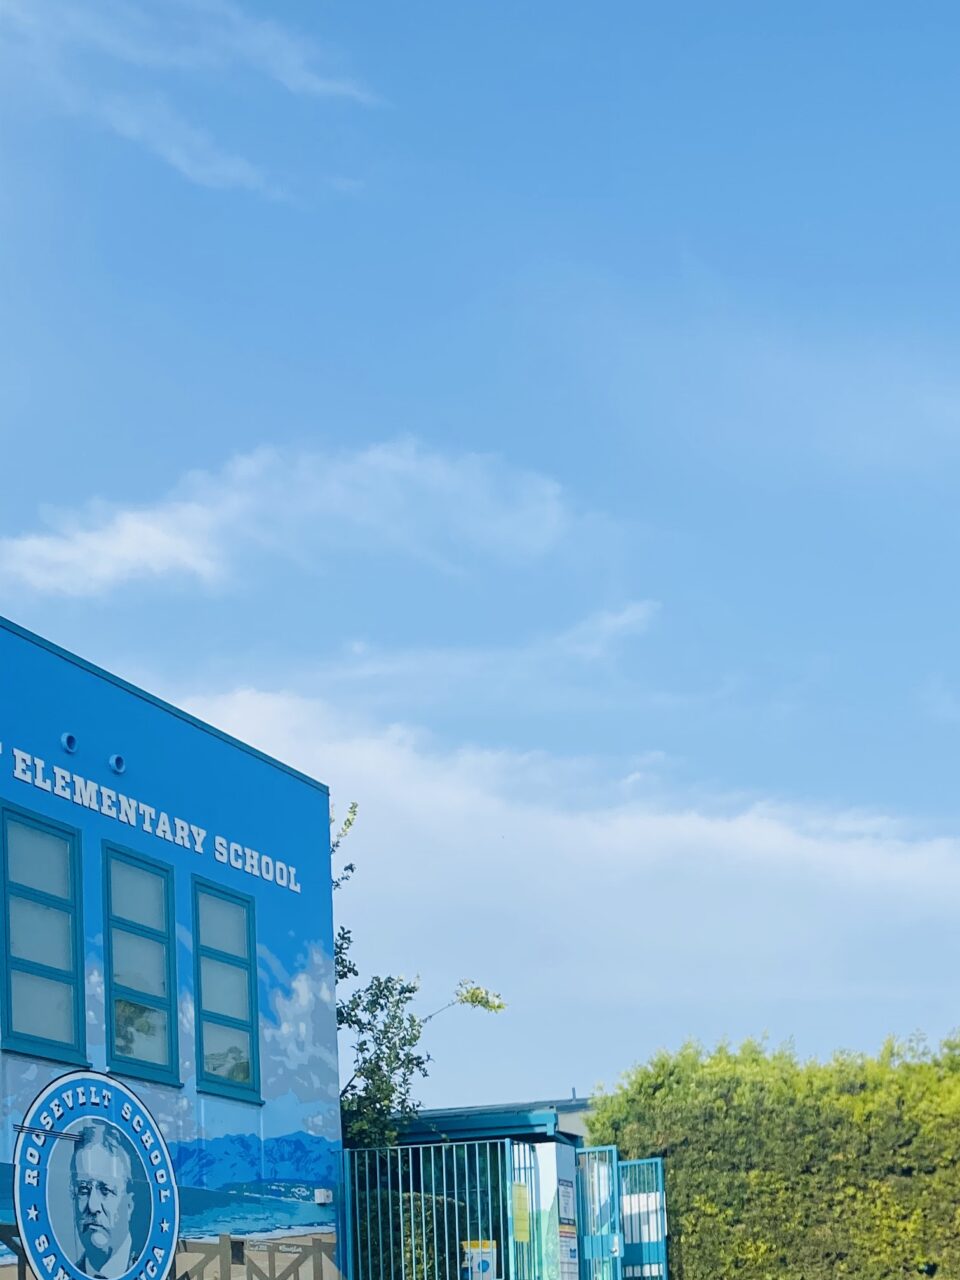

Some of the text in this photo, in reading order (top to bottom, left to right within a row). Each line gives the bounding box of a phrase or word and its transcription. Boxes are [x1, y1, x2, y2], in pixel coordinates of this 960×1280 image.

[12, 748, 301, 894] ELEMENTARY SCHOOL
[24, 1086, 171, 1204] ROOSEVELT SCHOOL
